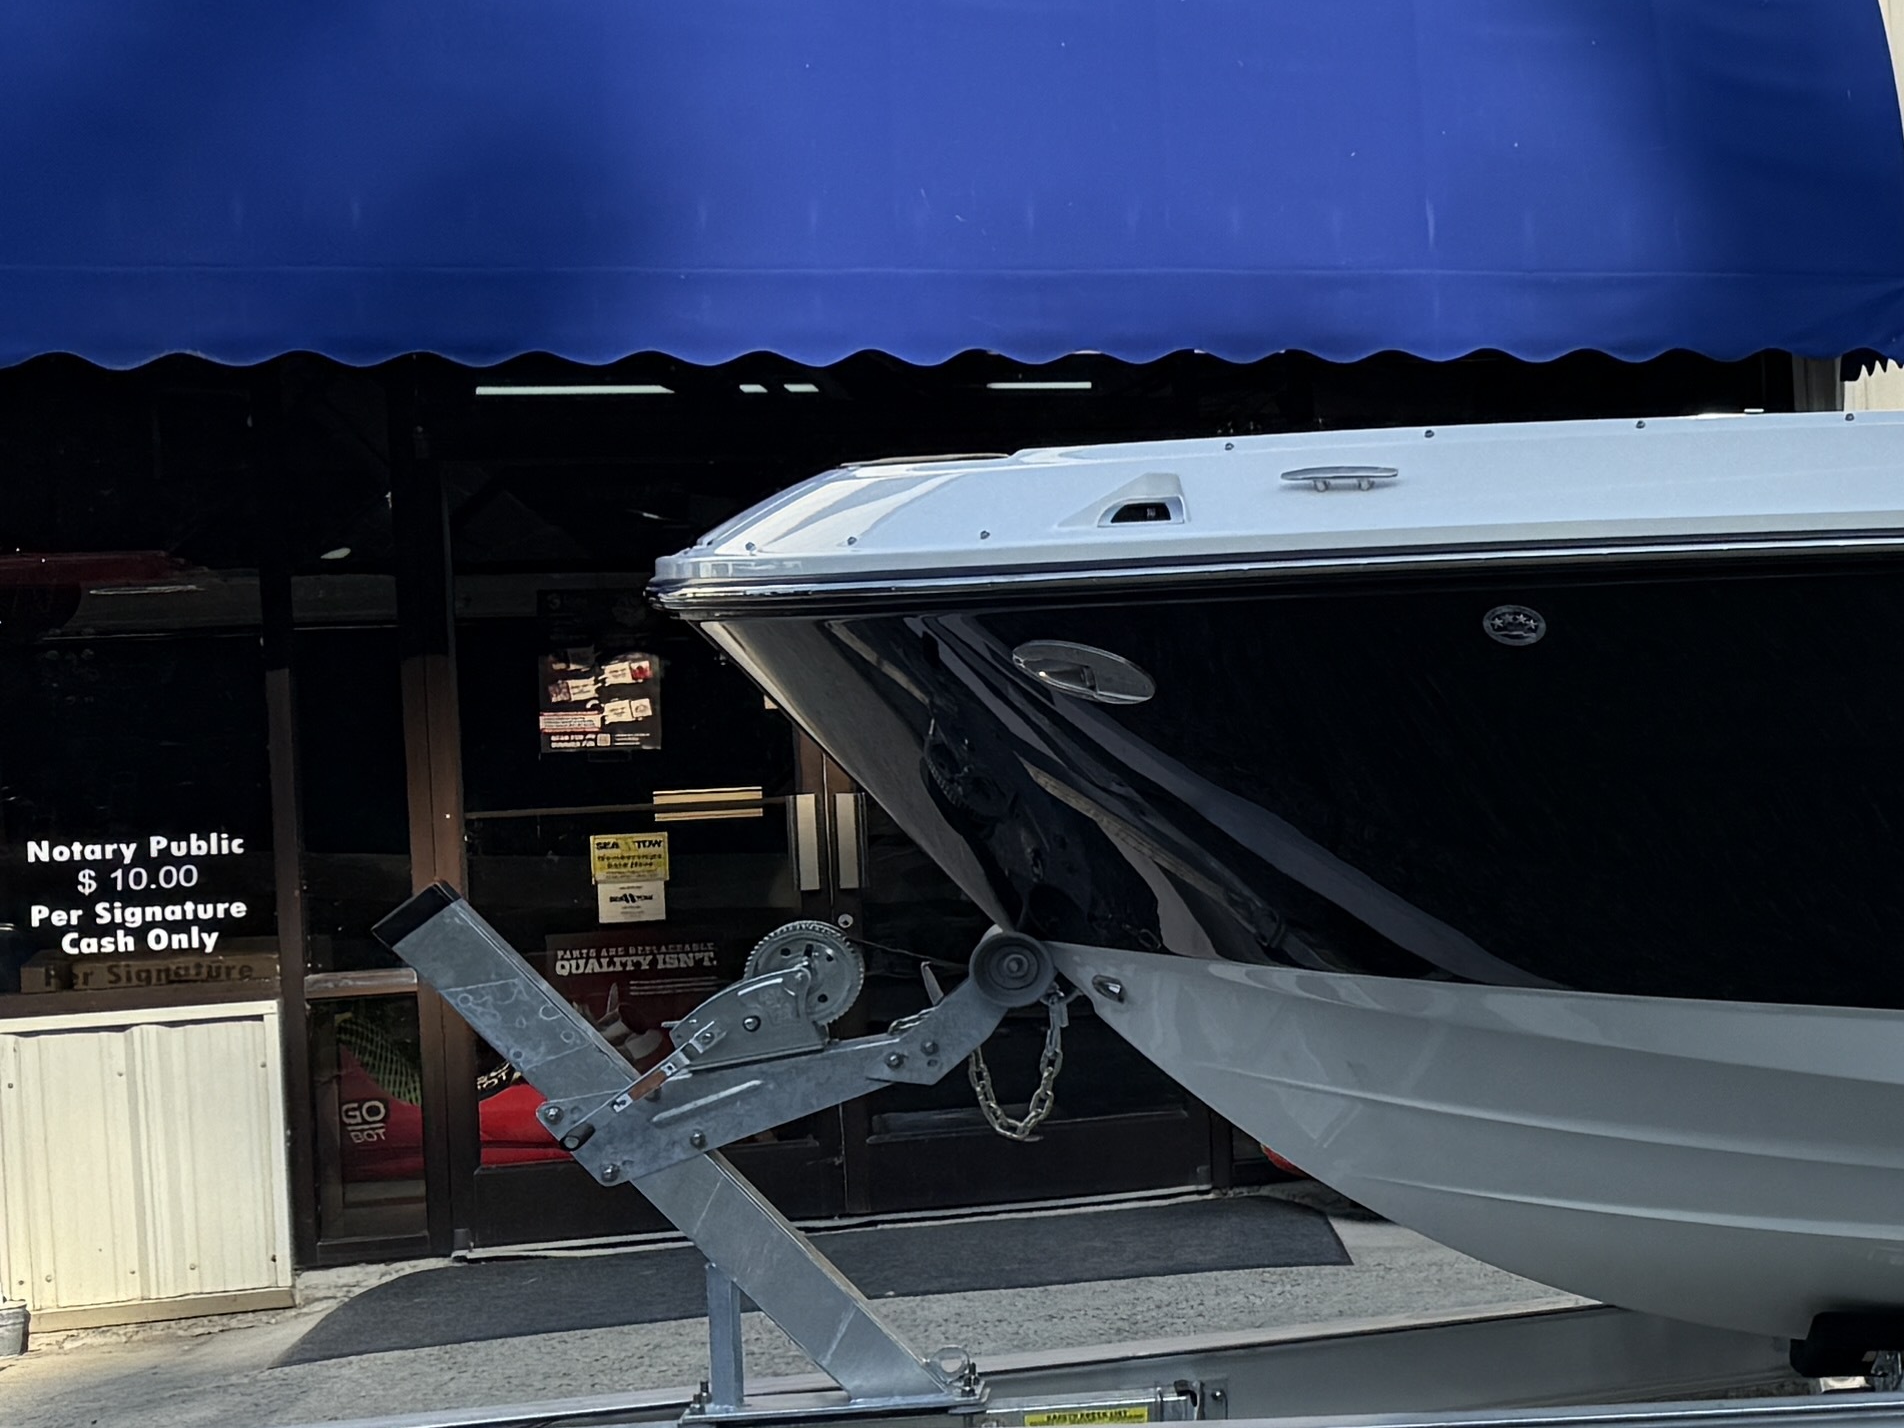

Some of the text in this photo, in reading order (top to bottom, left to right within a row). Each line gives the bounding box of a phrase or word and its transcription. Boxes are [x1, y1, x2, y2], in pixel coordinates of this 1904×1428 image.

[27, 833, 245, 864] Notary Public
[77, 864, 199, 896] $ 10.00
[30, 901, 248, 928] Per Signature
[61, 926, 219, 955] Cash Only
[556, 948, 596, 959] PARTS
[601, 946, 625, 956] ARE
[555, 952, 717, 976] QUALITY ISN'T.
[341, 1100, 386, 1124] GO
[350, 1128, 386, 1143] BOT
